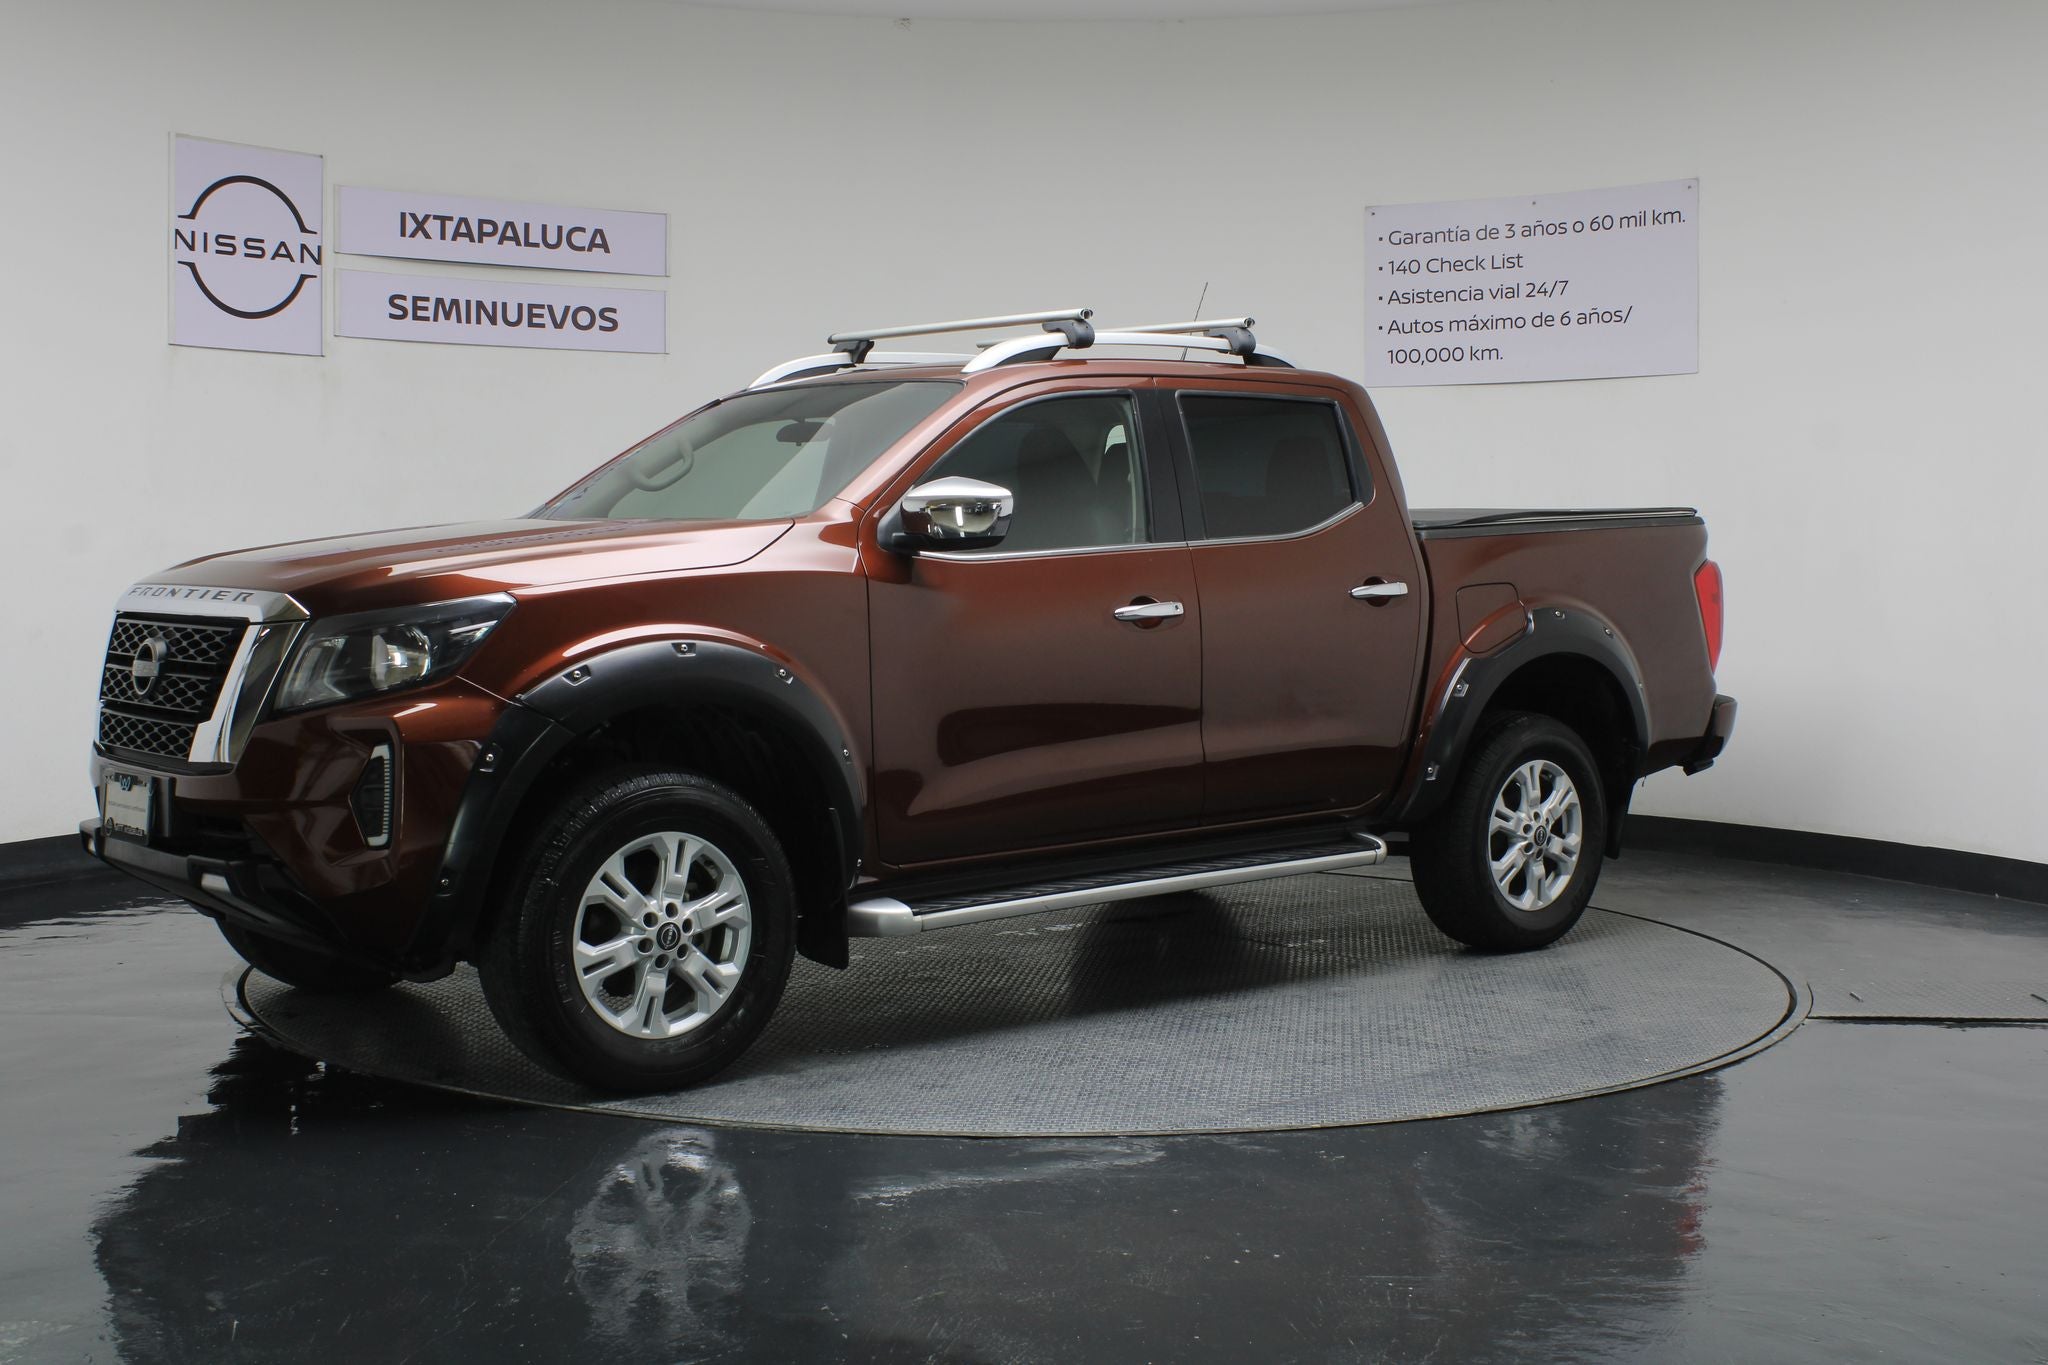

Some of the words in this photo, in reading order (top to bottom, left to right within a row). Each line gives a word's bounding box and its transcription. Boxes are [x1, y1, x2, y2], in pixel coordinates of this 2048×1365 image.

[399, 211, 611, 254] IXTAPALUCA
[1388, 225, 1470, 246] Garantía
[1475, 224, 1500, 241] de
[1504, 223, 1516, 239] 3
[1520, 219, 1568, 238] años
[1572, 220, 1585, 234] o
[1589, 214, 1615, 232] 60
[1619, 209, 1647, 229] mil
[1652, 209, 1686, 226] km.
[174, 229, 323, 266] NISSAN
[1388, 259, 1421, 276] 140
[1425, 255, 1486, 274] Check
[1491, 253, 1524, 270] List
[1387, 285, 1484, 305] Asistencia
[1488, 282, 1520, 300] vial
[1525, 279, 1569, 299] 24/7
[388, 293, 619, 333] SEMINUEVOS
[1387, 318, 1444, 335] Autos
[1448, 313, 1527, 333] máximo
[1531, 311, 1555, 329] de
[1559, 310, 1572, 327] 6
[1576, 305, 1633, 326] años/
[1387, 346, 1465, 366] 100,000
[1469, 345, 1504, 362] km.
[128, 586, 255, 602] FRONTIER
